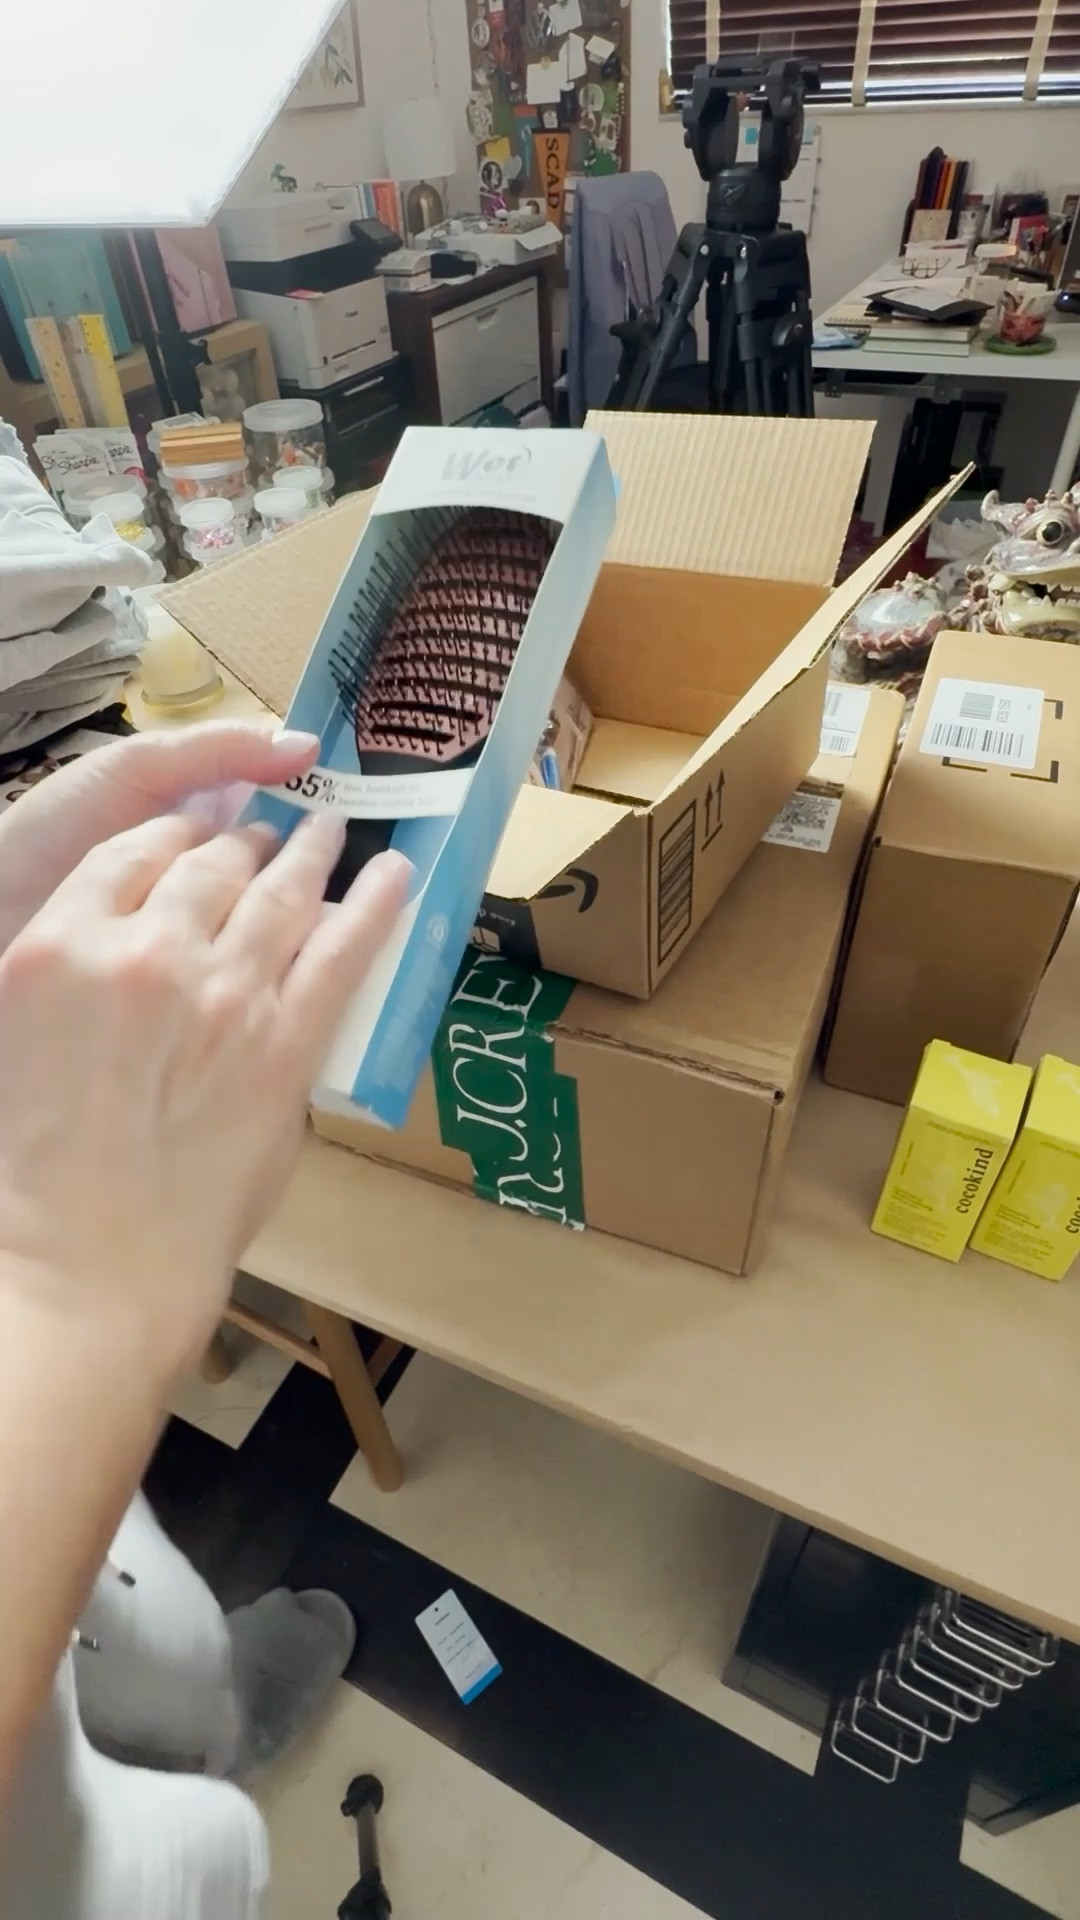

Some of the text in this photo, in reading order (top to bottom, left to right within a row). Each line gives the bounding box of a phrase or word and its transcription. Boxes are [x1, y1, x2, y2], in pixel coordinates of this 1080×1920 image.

[546, 137, 560, 209] SCAD
[58, 455, 101, 476] Sharpie
[956, 1147, 995, 1215] cocokind
